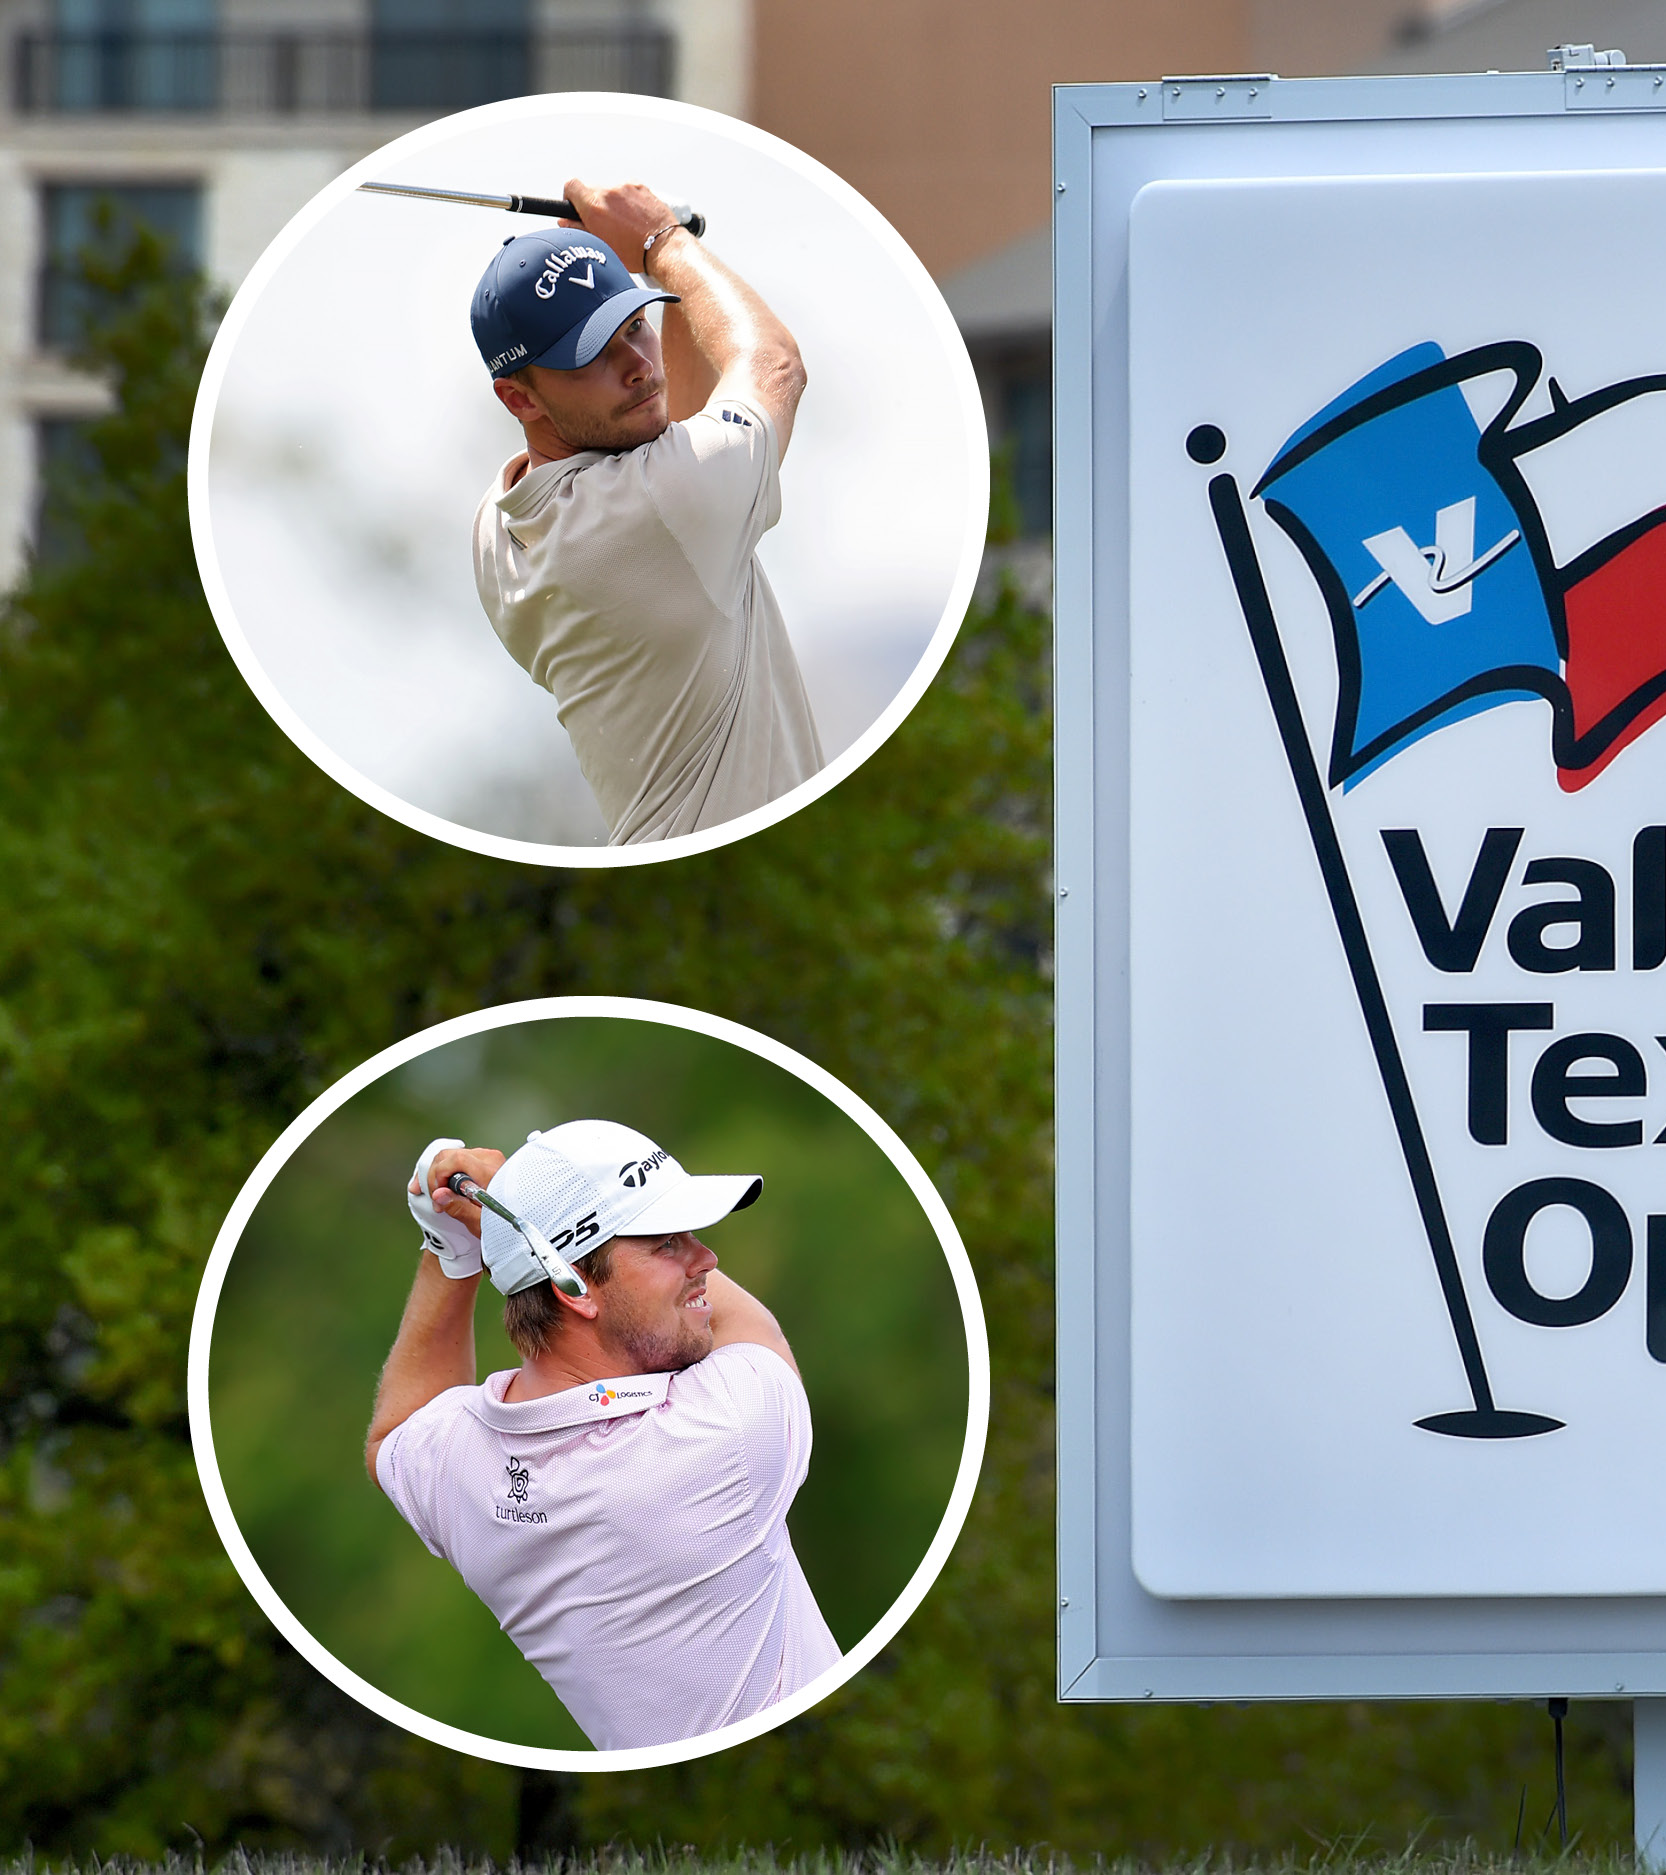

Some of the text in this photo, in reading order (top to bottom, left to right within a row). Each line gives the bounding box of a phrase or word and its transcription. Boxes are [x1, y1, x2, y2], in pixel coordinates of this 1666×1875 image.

[535, 246, 607, 300] Callaway
[588, 1390, 653, 1403] CJ LOGISTICS
[495, 1505, 548, 1525] turtleson
